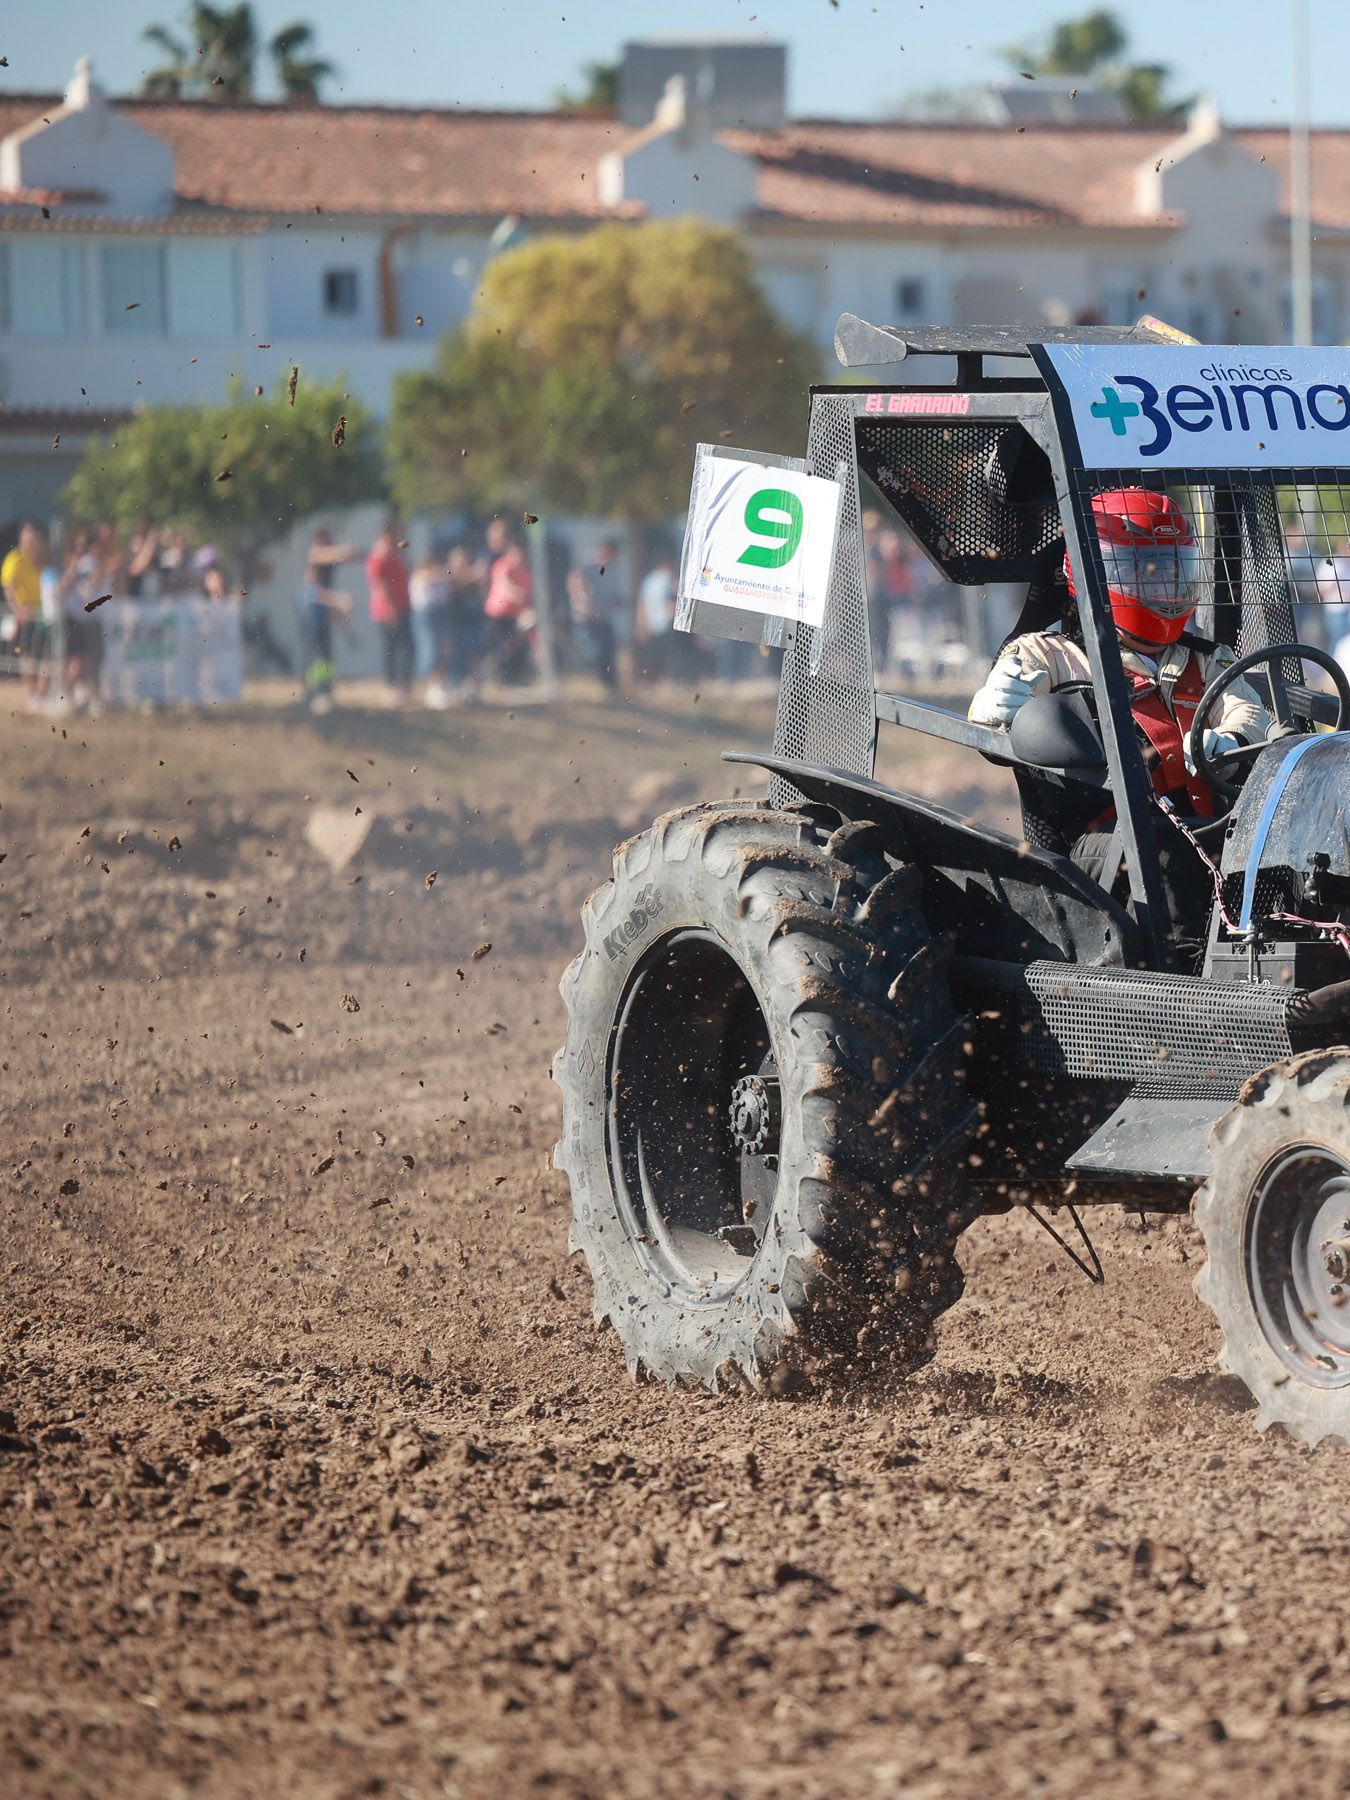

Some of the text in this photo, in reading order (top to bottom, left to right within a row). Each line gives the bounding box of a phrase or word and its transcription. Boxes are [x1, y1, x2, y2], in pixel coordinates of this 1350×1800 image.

[1199, 362, 1293, 382] clínicas
[864, 393, 884, 412] EL
[736, 488, 803, 569] 9
[714, 572, 771, 591] Ayuntamiento
